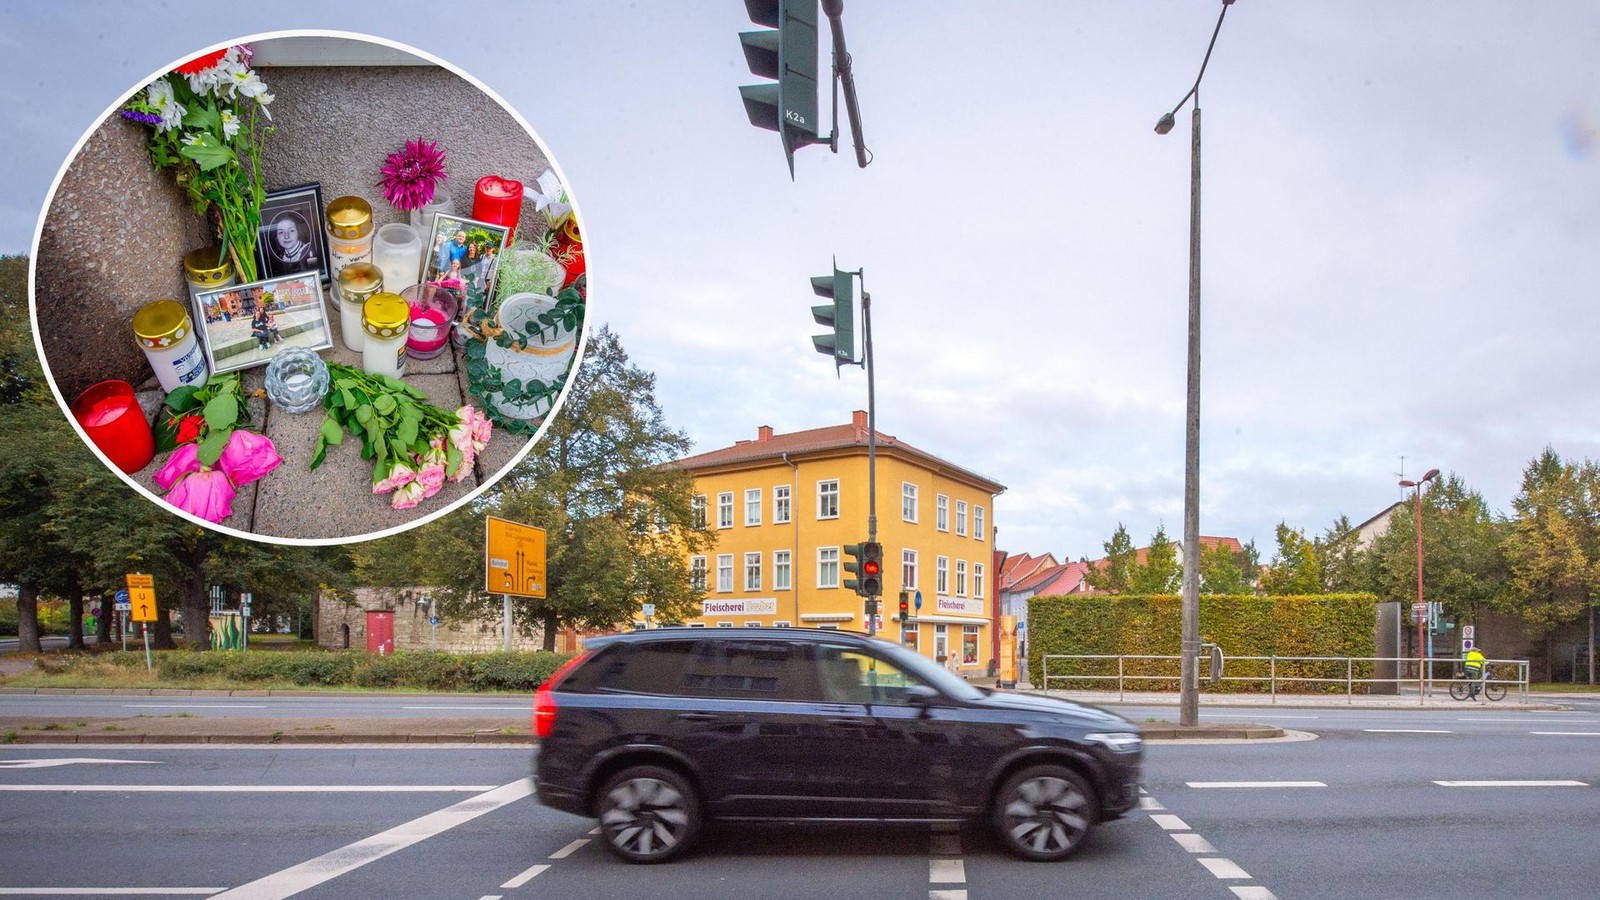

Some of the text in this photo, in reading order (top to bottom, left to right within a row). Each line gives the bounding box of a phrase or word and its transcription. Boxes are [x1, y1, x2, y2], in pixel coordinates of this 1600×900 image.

[786, 109, 805, 124] K2a
[704, 602, 744, 613] Fleischerei
[938, 599, 965, 610] Fleischerei
